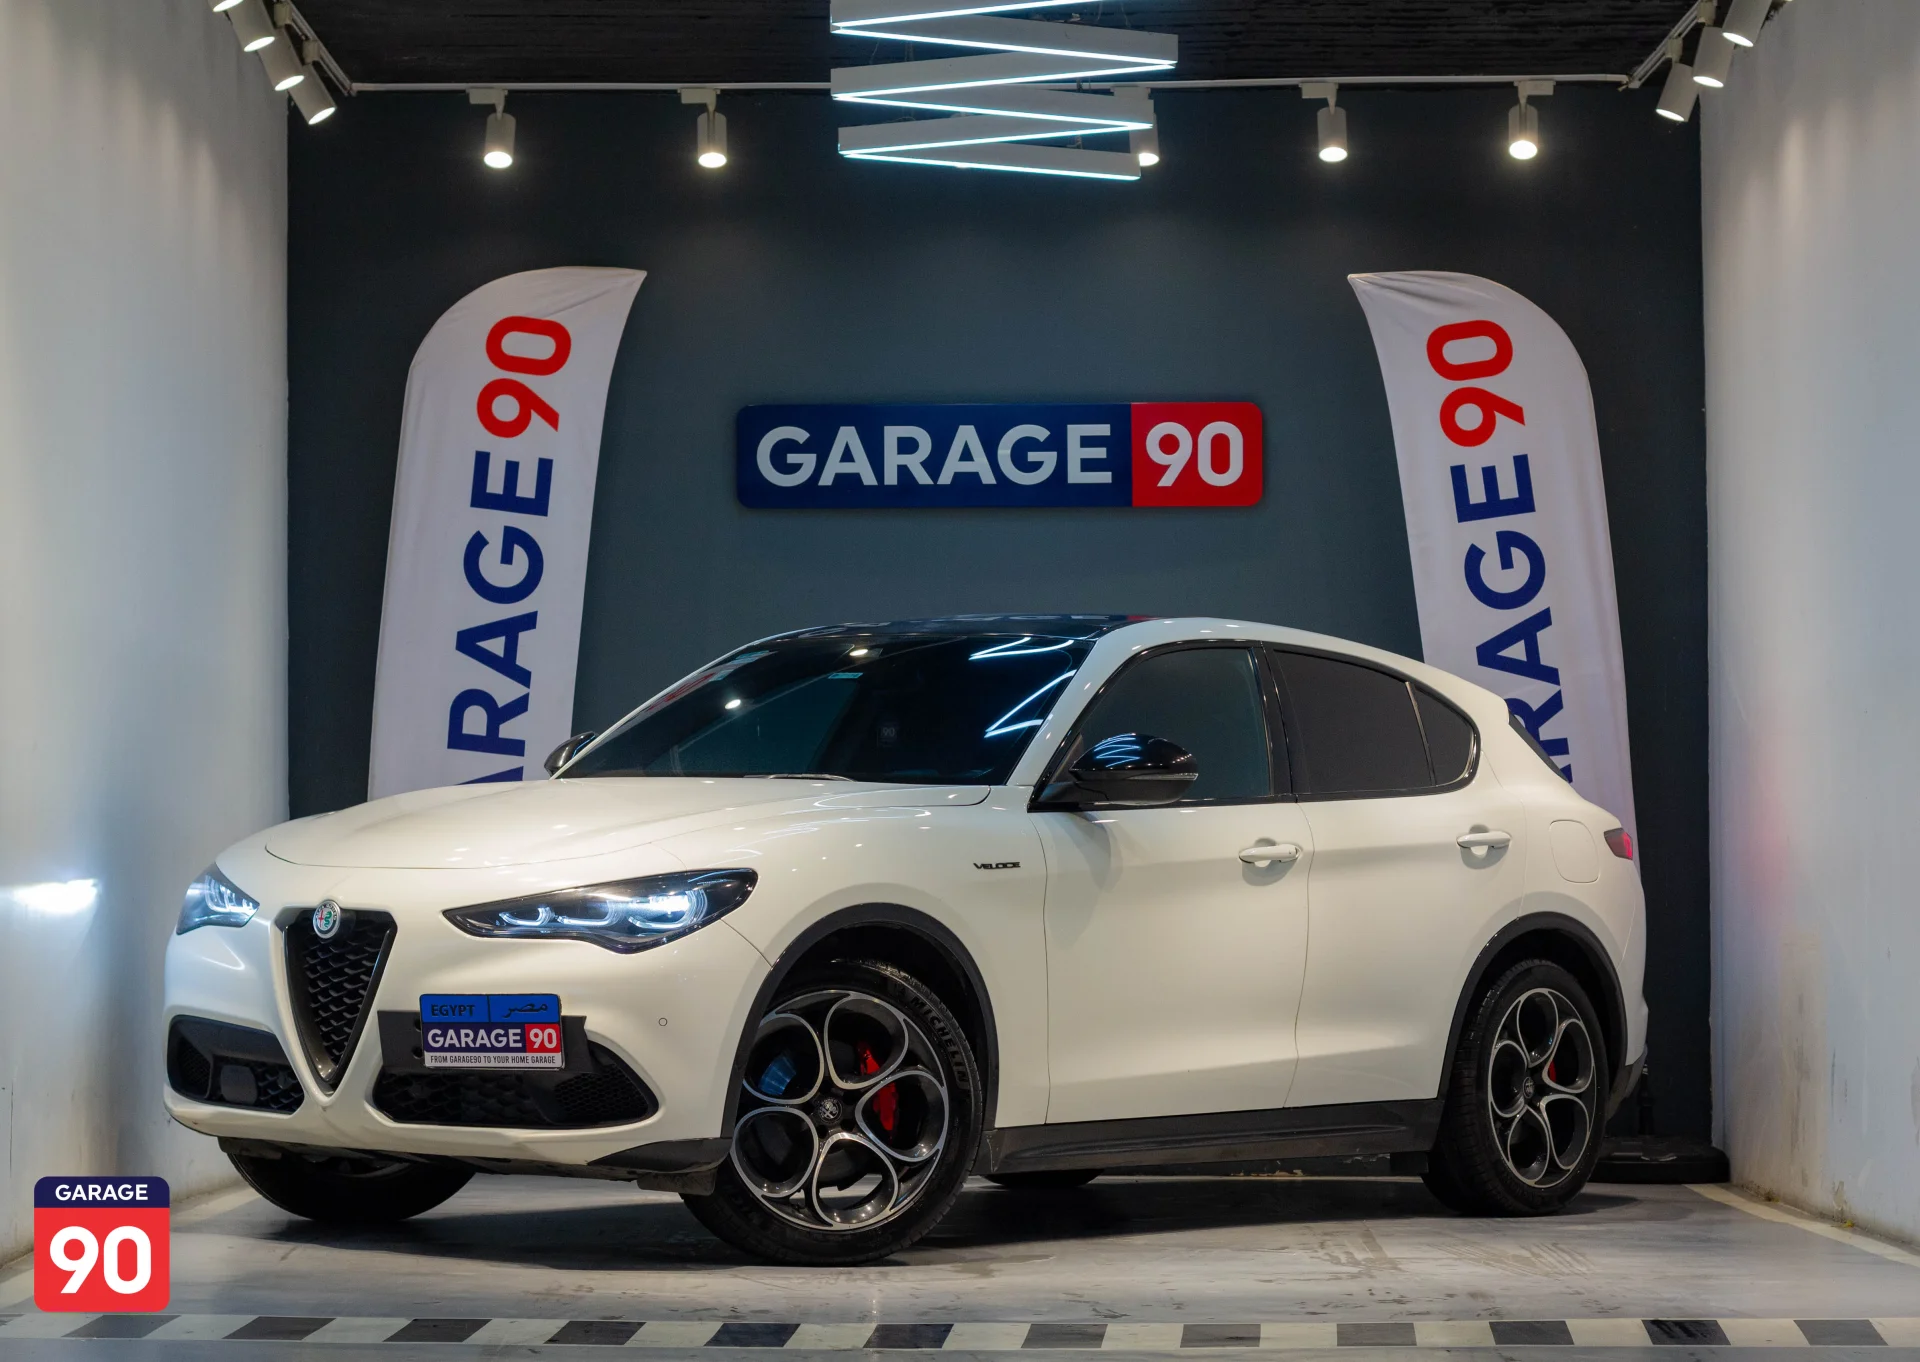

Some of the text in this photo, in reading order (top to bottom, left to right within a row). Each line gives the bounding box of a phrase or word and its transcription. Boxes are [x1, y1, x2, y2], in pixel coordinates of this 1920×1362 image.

[756, 421, 1244, 487] GARAGE 90
[973, 861, 1021, 869] VELOCE
[431, 1004, 475, 1017] EGYPT
[502, 1003, 548, 1019] مصر
[427, 1028, 557, 1049] GARAGE 90
[910, 996, 970, 1084] MICHELIN
[430, 1055, 556, 1064] FROM GARAGE90 TO YOUR HOME GARAGE
